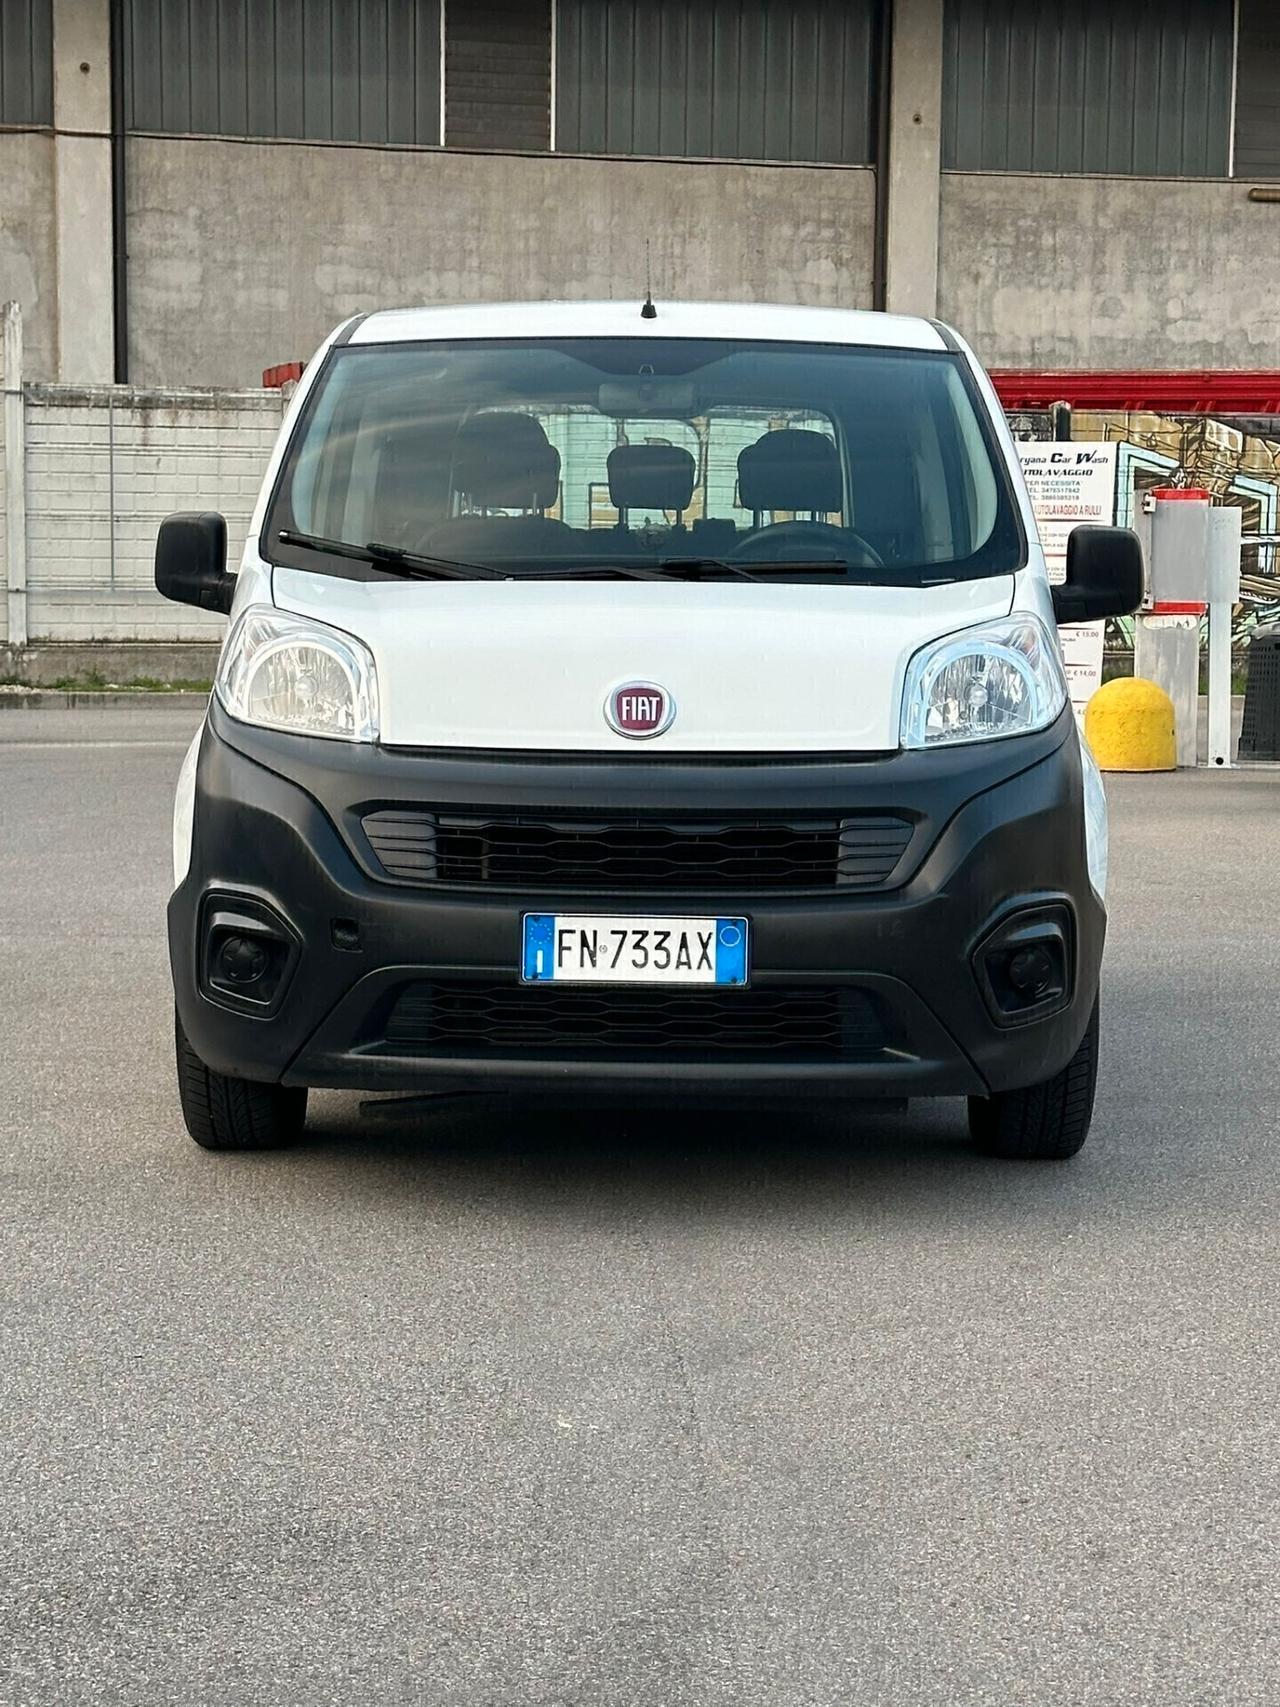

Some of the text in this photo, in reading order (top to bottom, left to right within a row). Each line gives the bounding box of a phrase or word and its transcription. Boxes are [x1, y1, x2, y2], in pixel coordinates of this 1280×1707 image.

[1020, 449, 1109, 466] ryana Car Wash
[622, 696, 660, 721] FIAT
